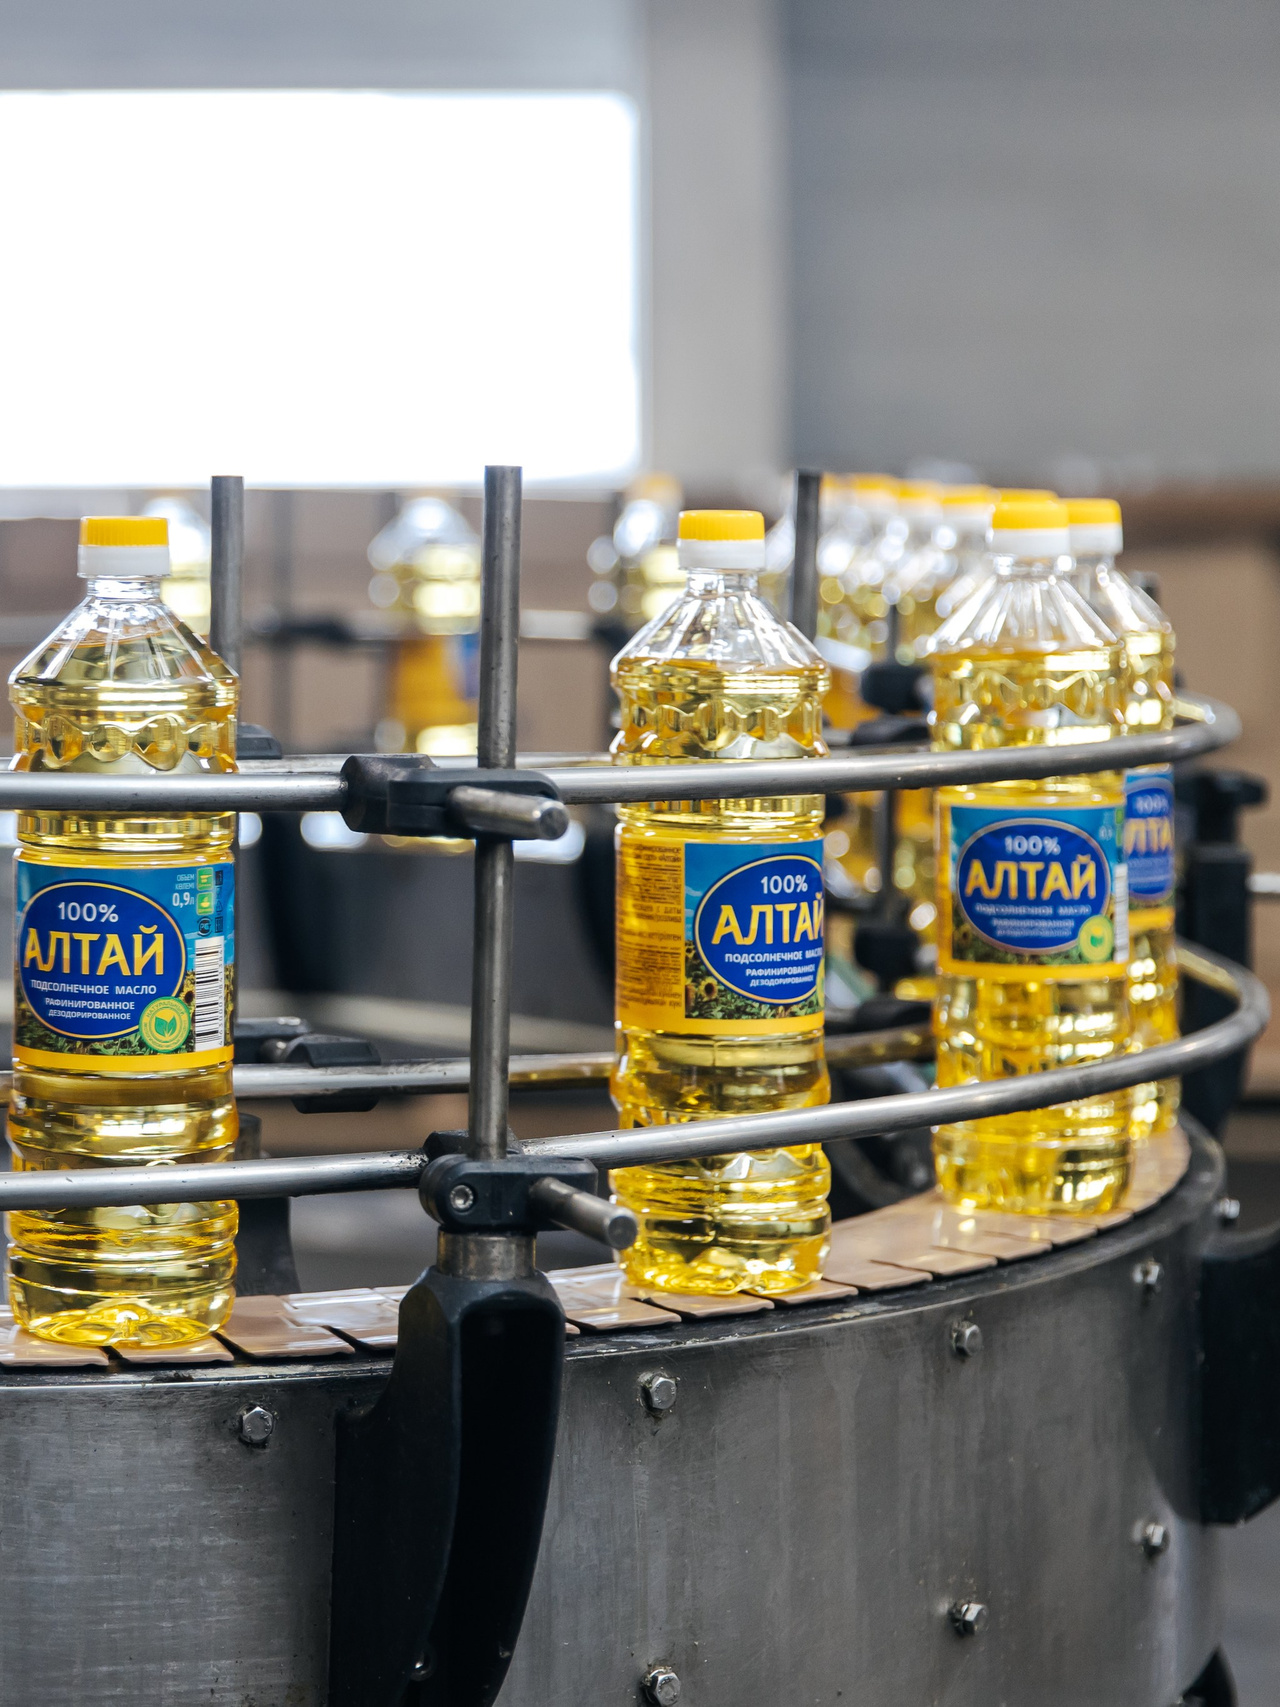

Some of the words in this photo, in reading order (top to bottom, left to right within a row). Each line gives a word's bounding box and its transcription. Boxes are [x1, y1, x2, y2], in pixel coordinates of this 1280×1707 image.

[1004, 835, 1061, 856] 100%
[760, 874, 808, 894] 100%
[965, 853, 1096, 900] АЛТАЙ
[58, 902, 119, 923] 100%
[711, 892, 824, 945] АЛТАЙ
[23, 924, 164, 976] АЛТАЙ
[725, 951, 803, 965] ПОДСОЛНЕЧНОЕ
[746, 963, 815, 977] РАФИНИРОВАННОЕ
[30, 979, 109, 995] ПОДСОЛНЕЧНОЕ
[115, 985, 157, 995] МАСЛО
[45, 997, 135, 1010] РАФИНИРОВАННОЕ
[48, 1010, 131, 1020] ДЕЗОДОРИРОВАННОЕ
